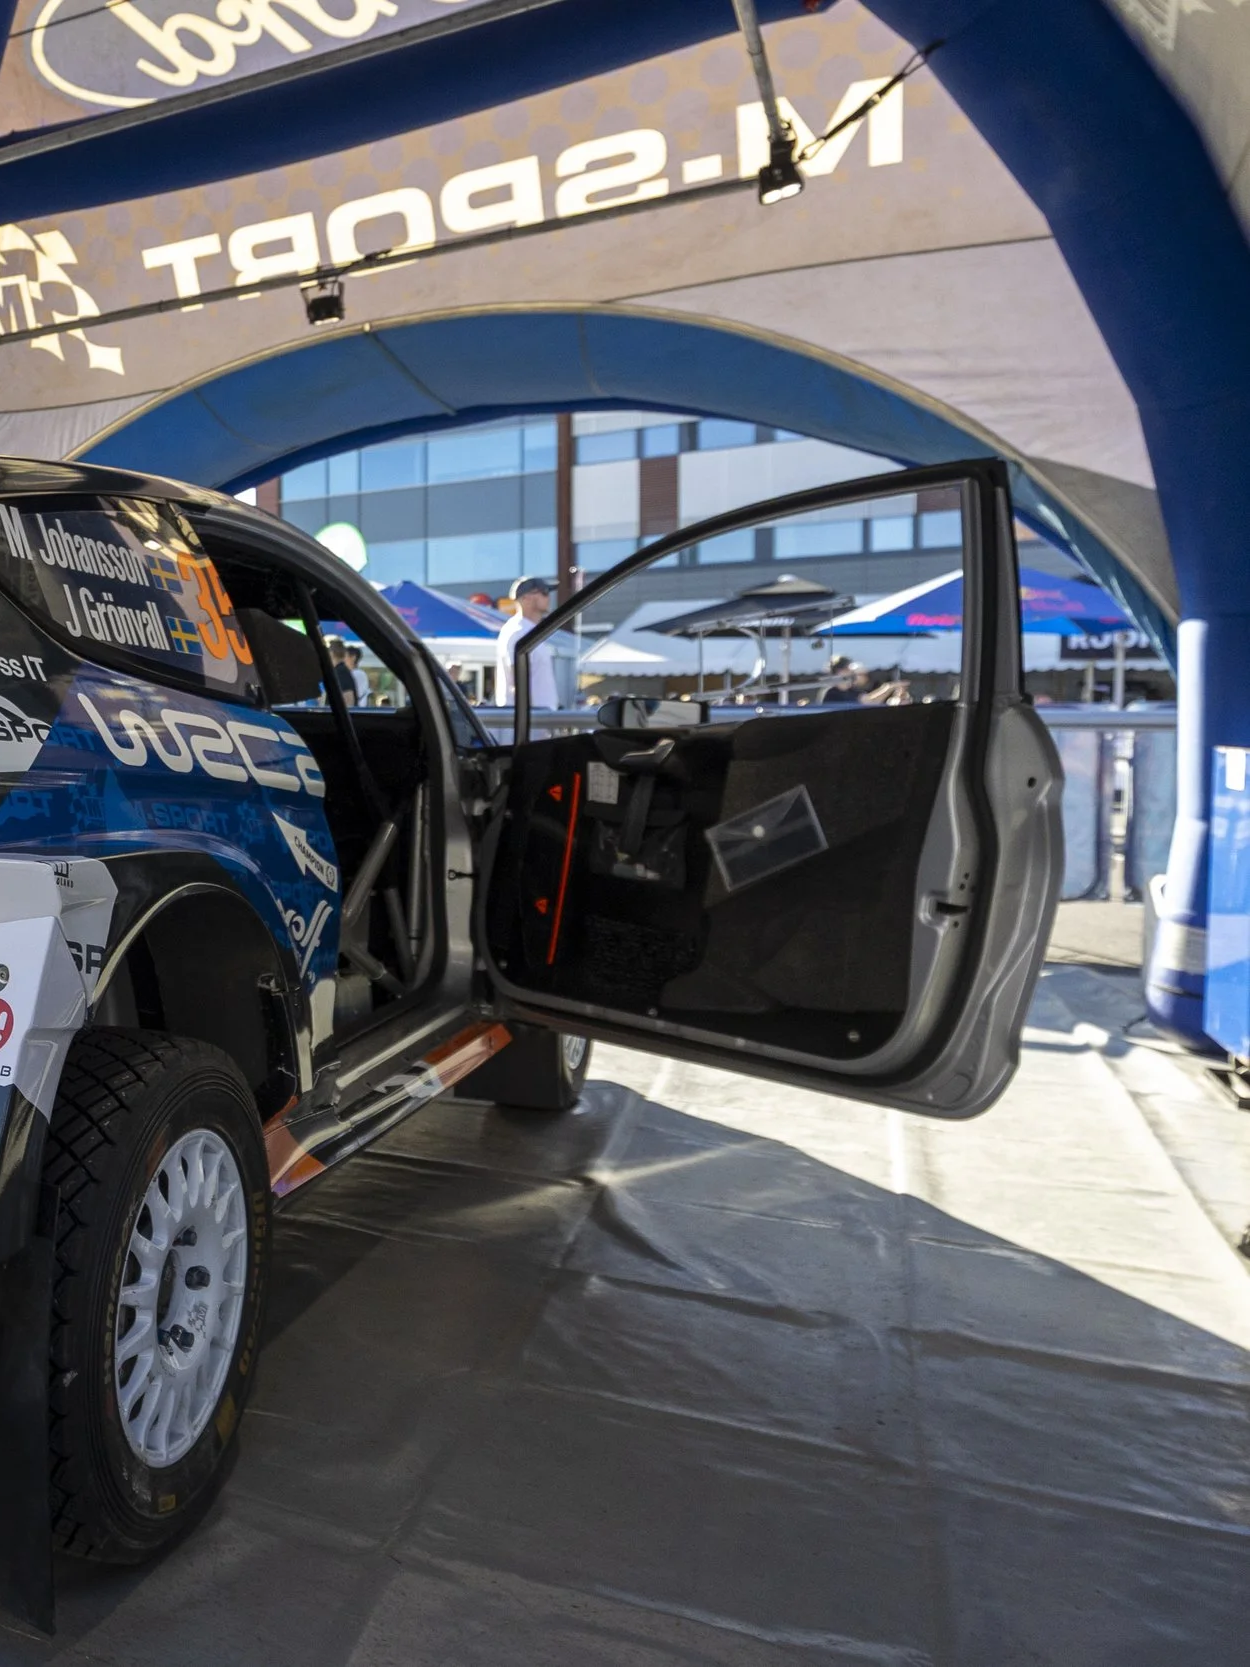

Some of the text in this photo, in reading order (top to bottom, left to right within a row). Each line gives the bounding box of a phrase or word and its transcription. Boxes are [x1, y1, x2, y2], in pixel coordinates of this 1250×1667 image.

[36, 513, 149, 587] Johansson
[63, 584, 170, 651] J Grönvall
[22, 655, 47, 682] IT
[294, 835, 325, 875] CHAMPION
